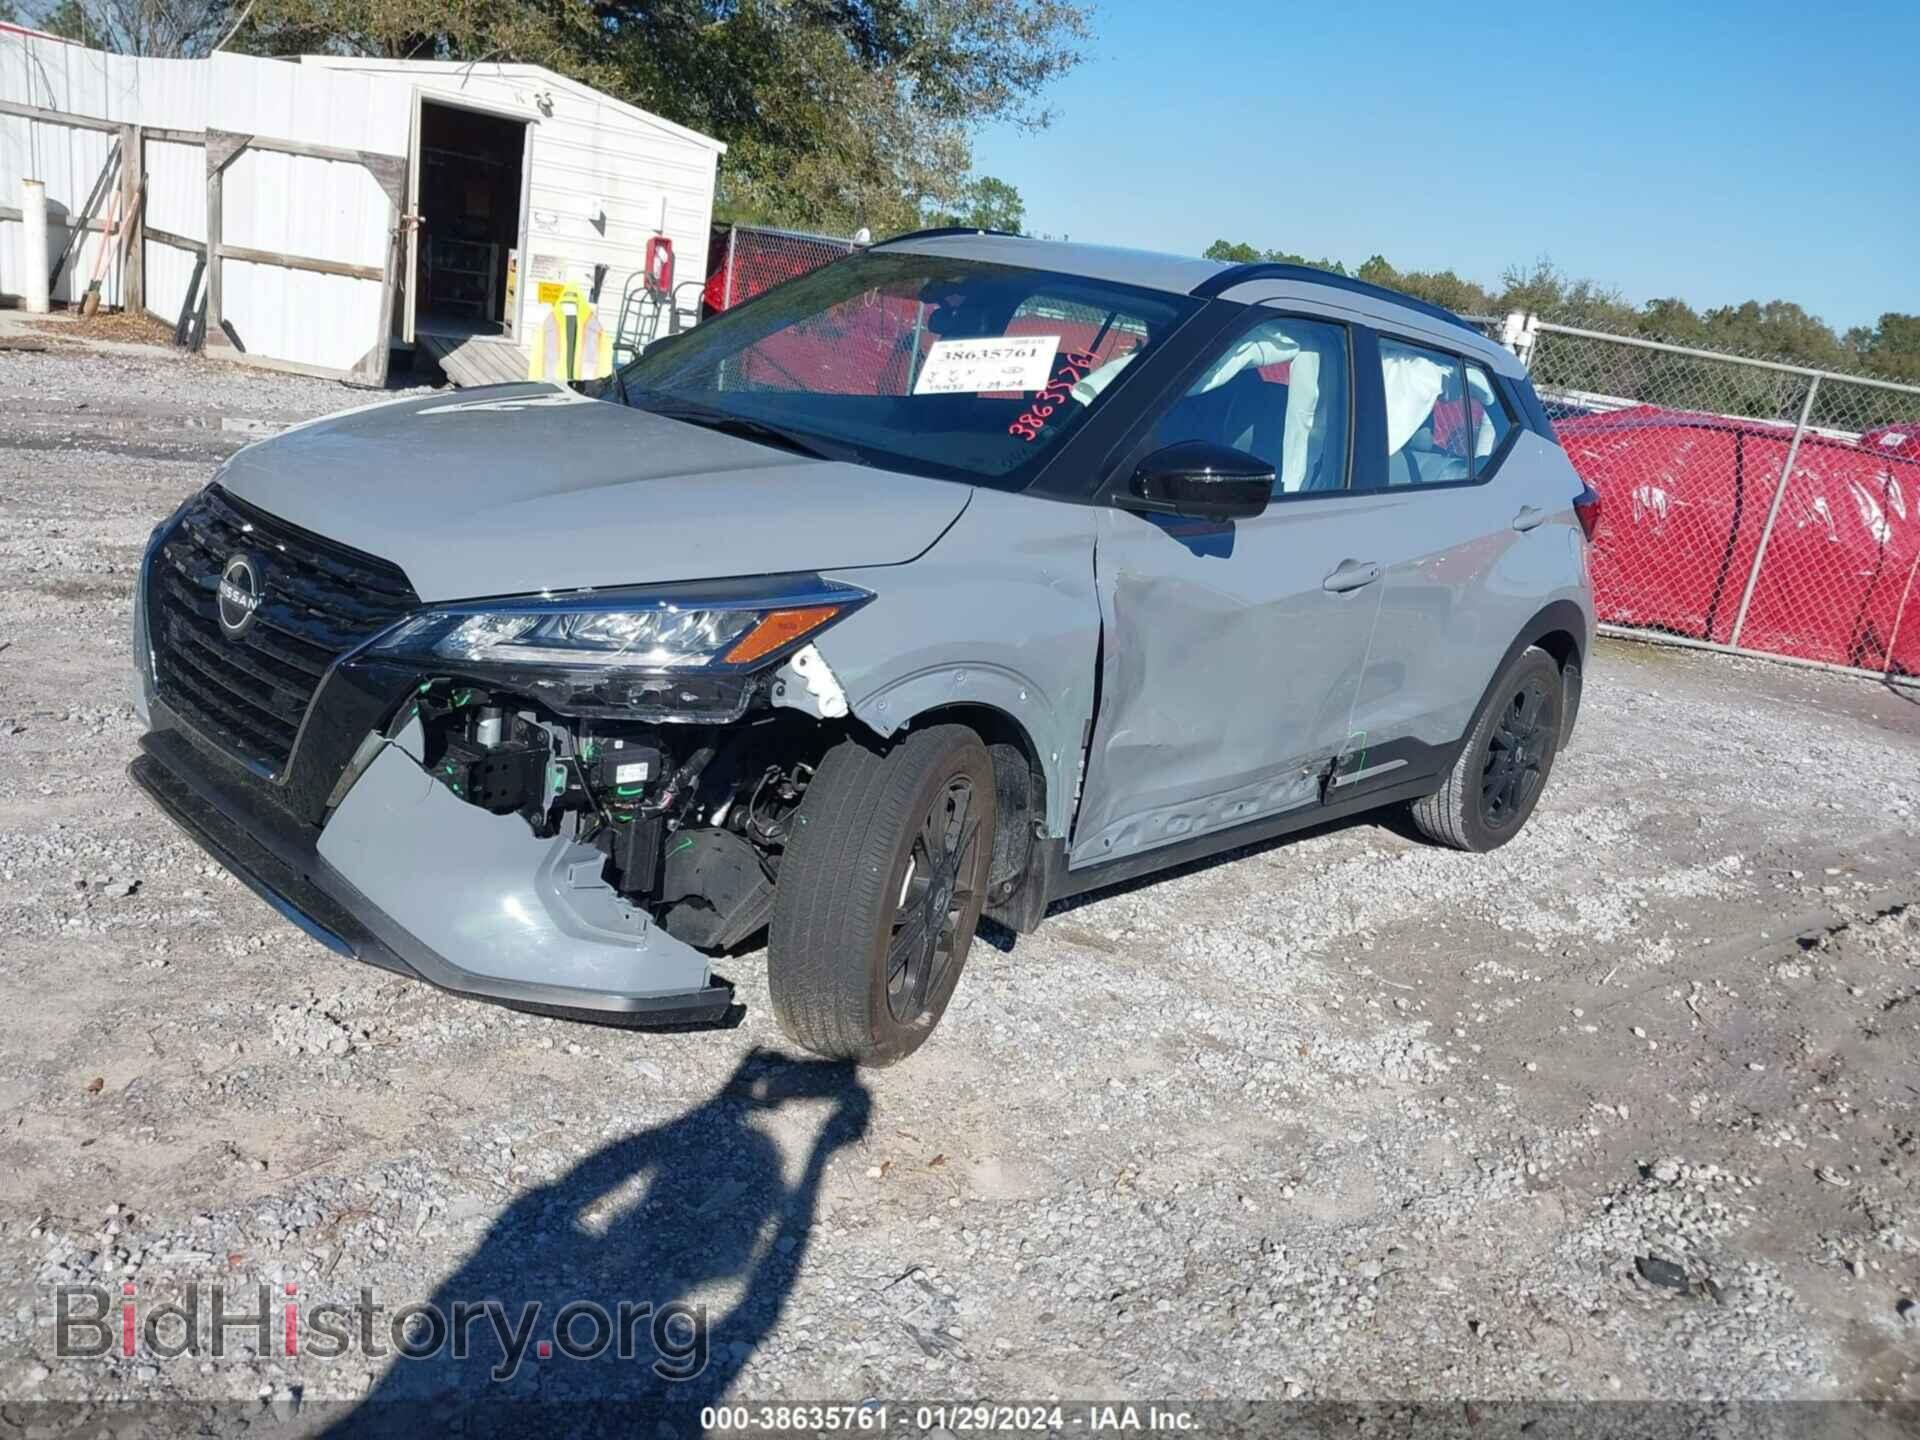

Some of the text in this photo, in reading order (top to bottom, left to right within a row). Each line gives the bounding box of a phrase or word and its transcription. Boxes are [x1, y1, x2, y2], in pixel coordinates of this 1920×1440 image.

[942, 348, 1038, 360] 38635761
[1008, 347, 1102, 441] 38635761
[219, 580, 258, 611] NISSAN
